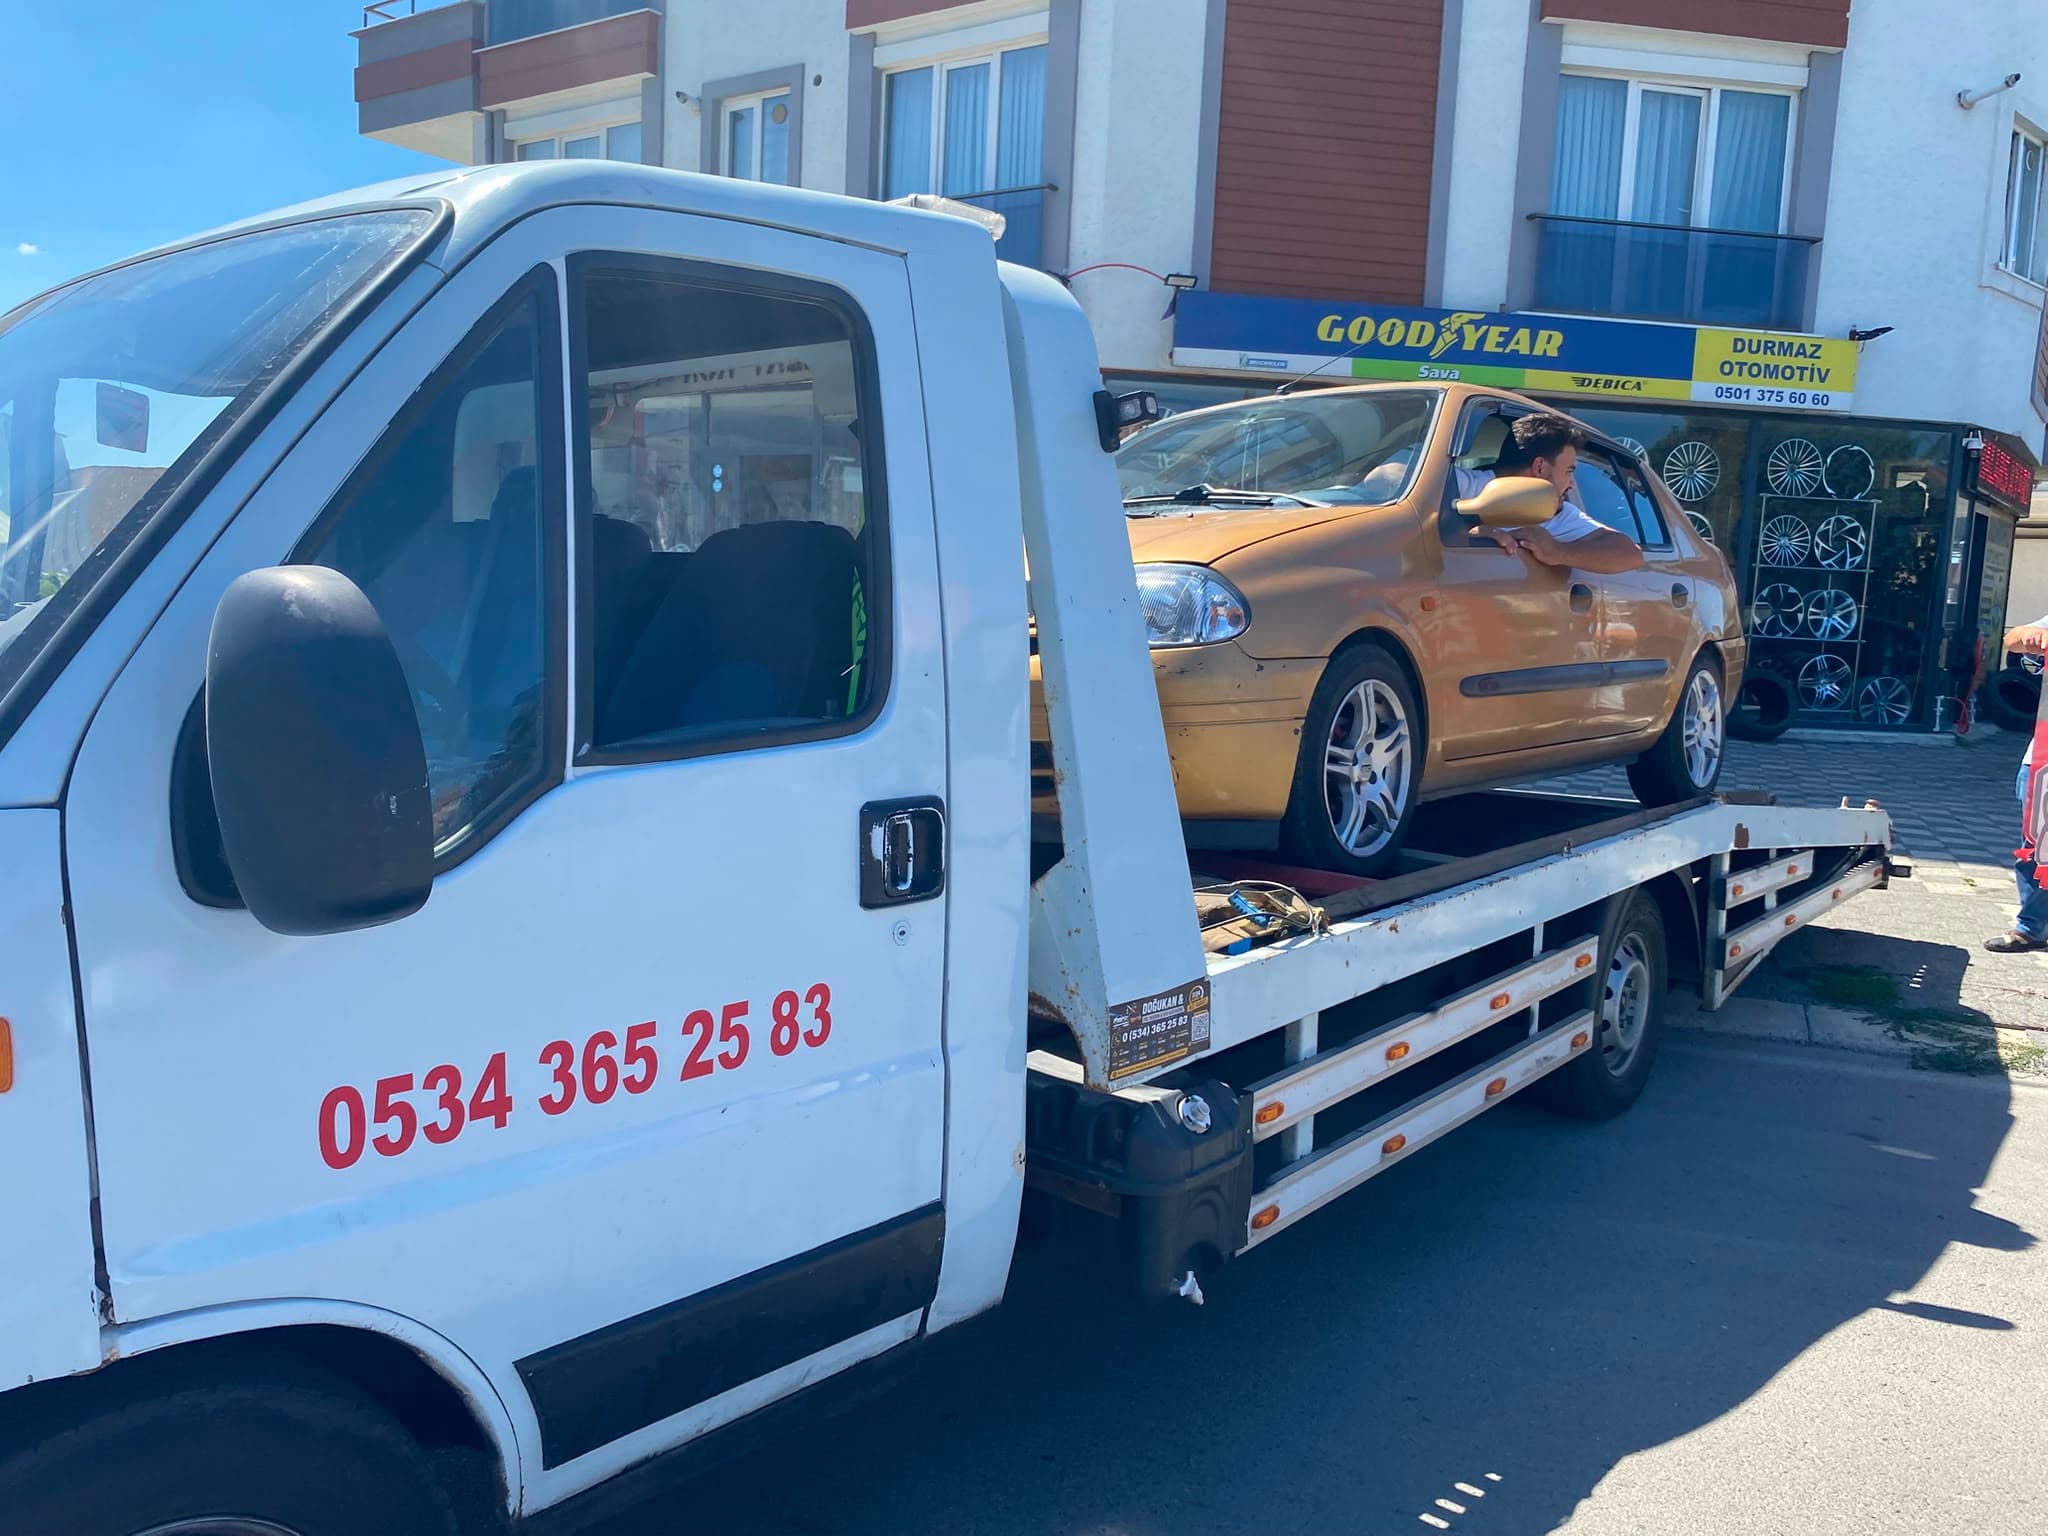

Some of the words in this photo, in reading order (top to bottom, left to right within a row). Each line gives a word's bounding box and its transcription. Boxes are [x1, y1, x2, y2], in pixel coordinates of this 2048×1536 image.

[1317, 314, 1435, 348] GOOD
[1462, 324, 1563, 357] YEAR
[1732, 337, 1823, 359] DURMAZ
[1418, 366, 1460, 380] Sava
[1719, 360, 1831, 383] OTOMOTİV
[1715, 386, 1751, 401] 0501
[1757, 389, 1784, 403] 375
[1788, 391, 1807, 405] 60
[1812, 393, 1830, 406] 60
[1142, 995, 1178, 1015] DOĞUKAN
[1122, 1032, 1128, 1042] 0
[1129, 1025, 1150, 1042] (534)
[1151, 1021, 1167, 1034] 365
[1167, 1018, 1178, 1030] 25
[1178, 1015, 1188, 1026] 83
[318, 1051, 513, 1170] 0534
[538, 1020, 658, 1116] 365
[680, 1000, 750, 1082] 25
[770, 982, 832, 1057] 83
